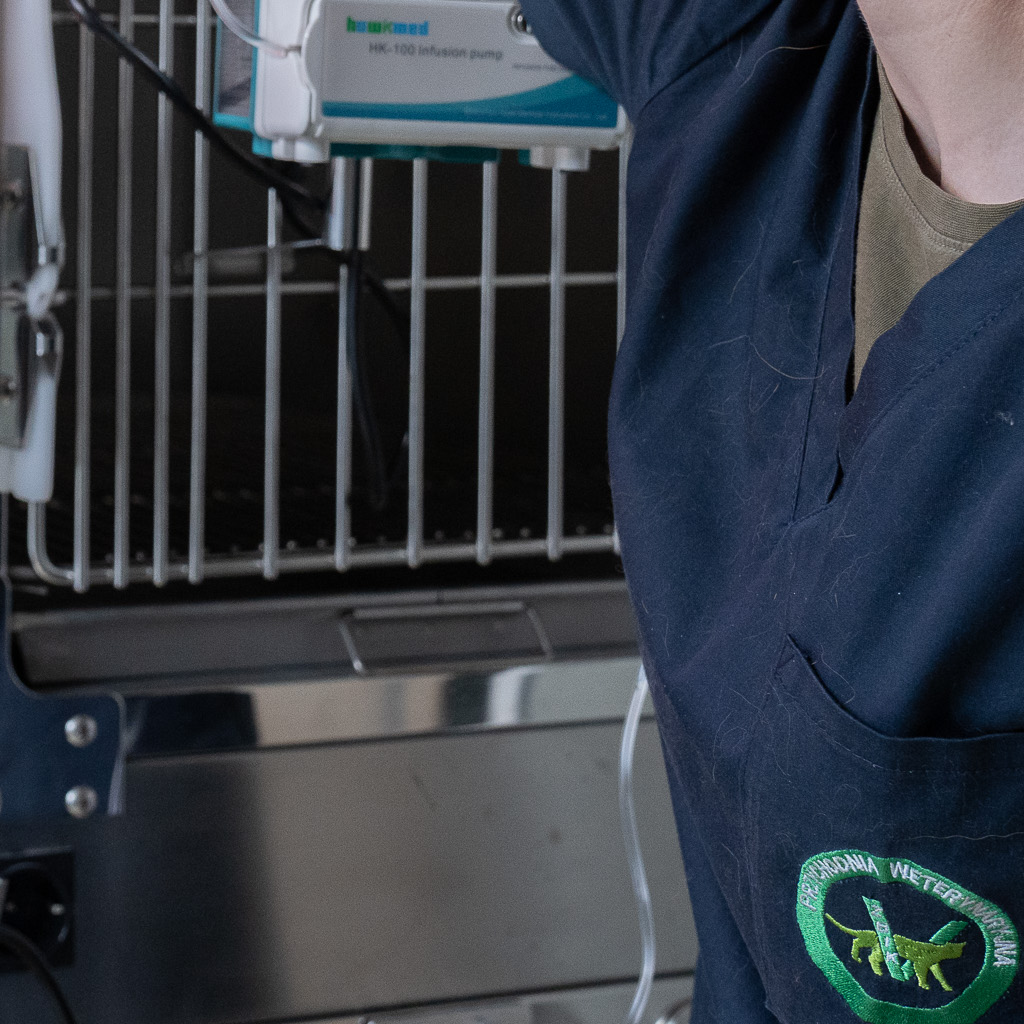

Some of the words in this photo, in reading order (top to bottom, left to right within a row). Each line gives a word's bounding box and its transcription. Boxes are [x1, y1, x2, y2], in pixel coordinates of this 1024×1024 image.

[369, 43, 416, 56] HK-100
[469, 49, 504, 61] pump
[800, 854, 879, 912] PRZYCHODNIA
